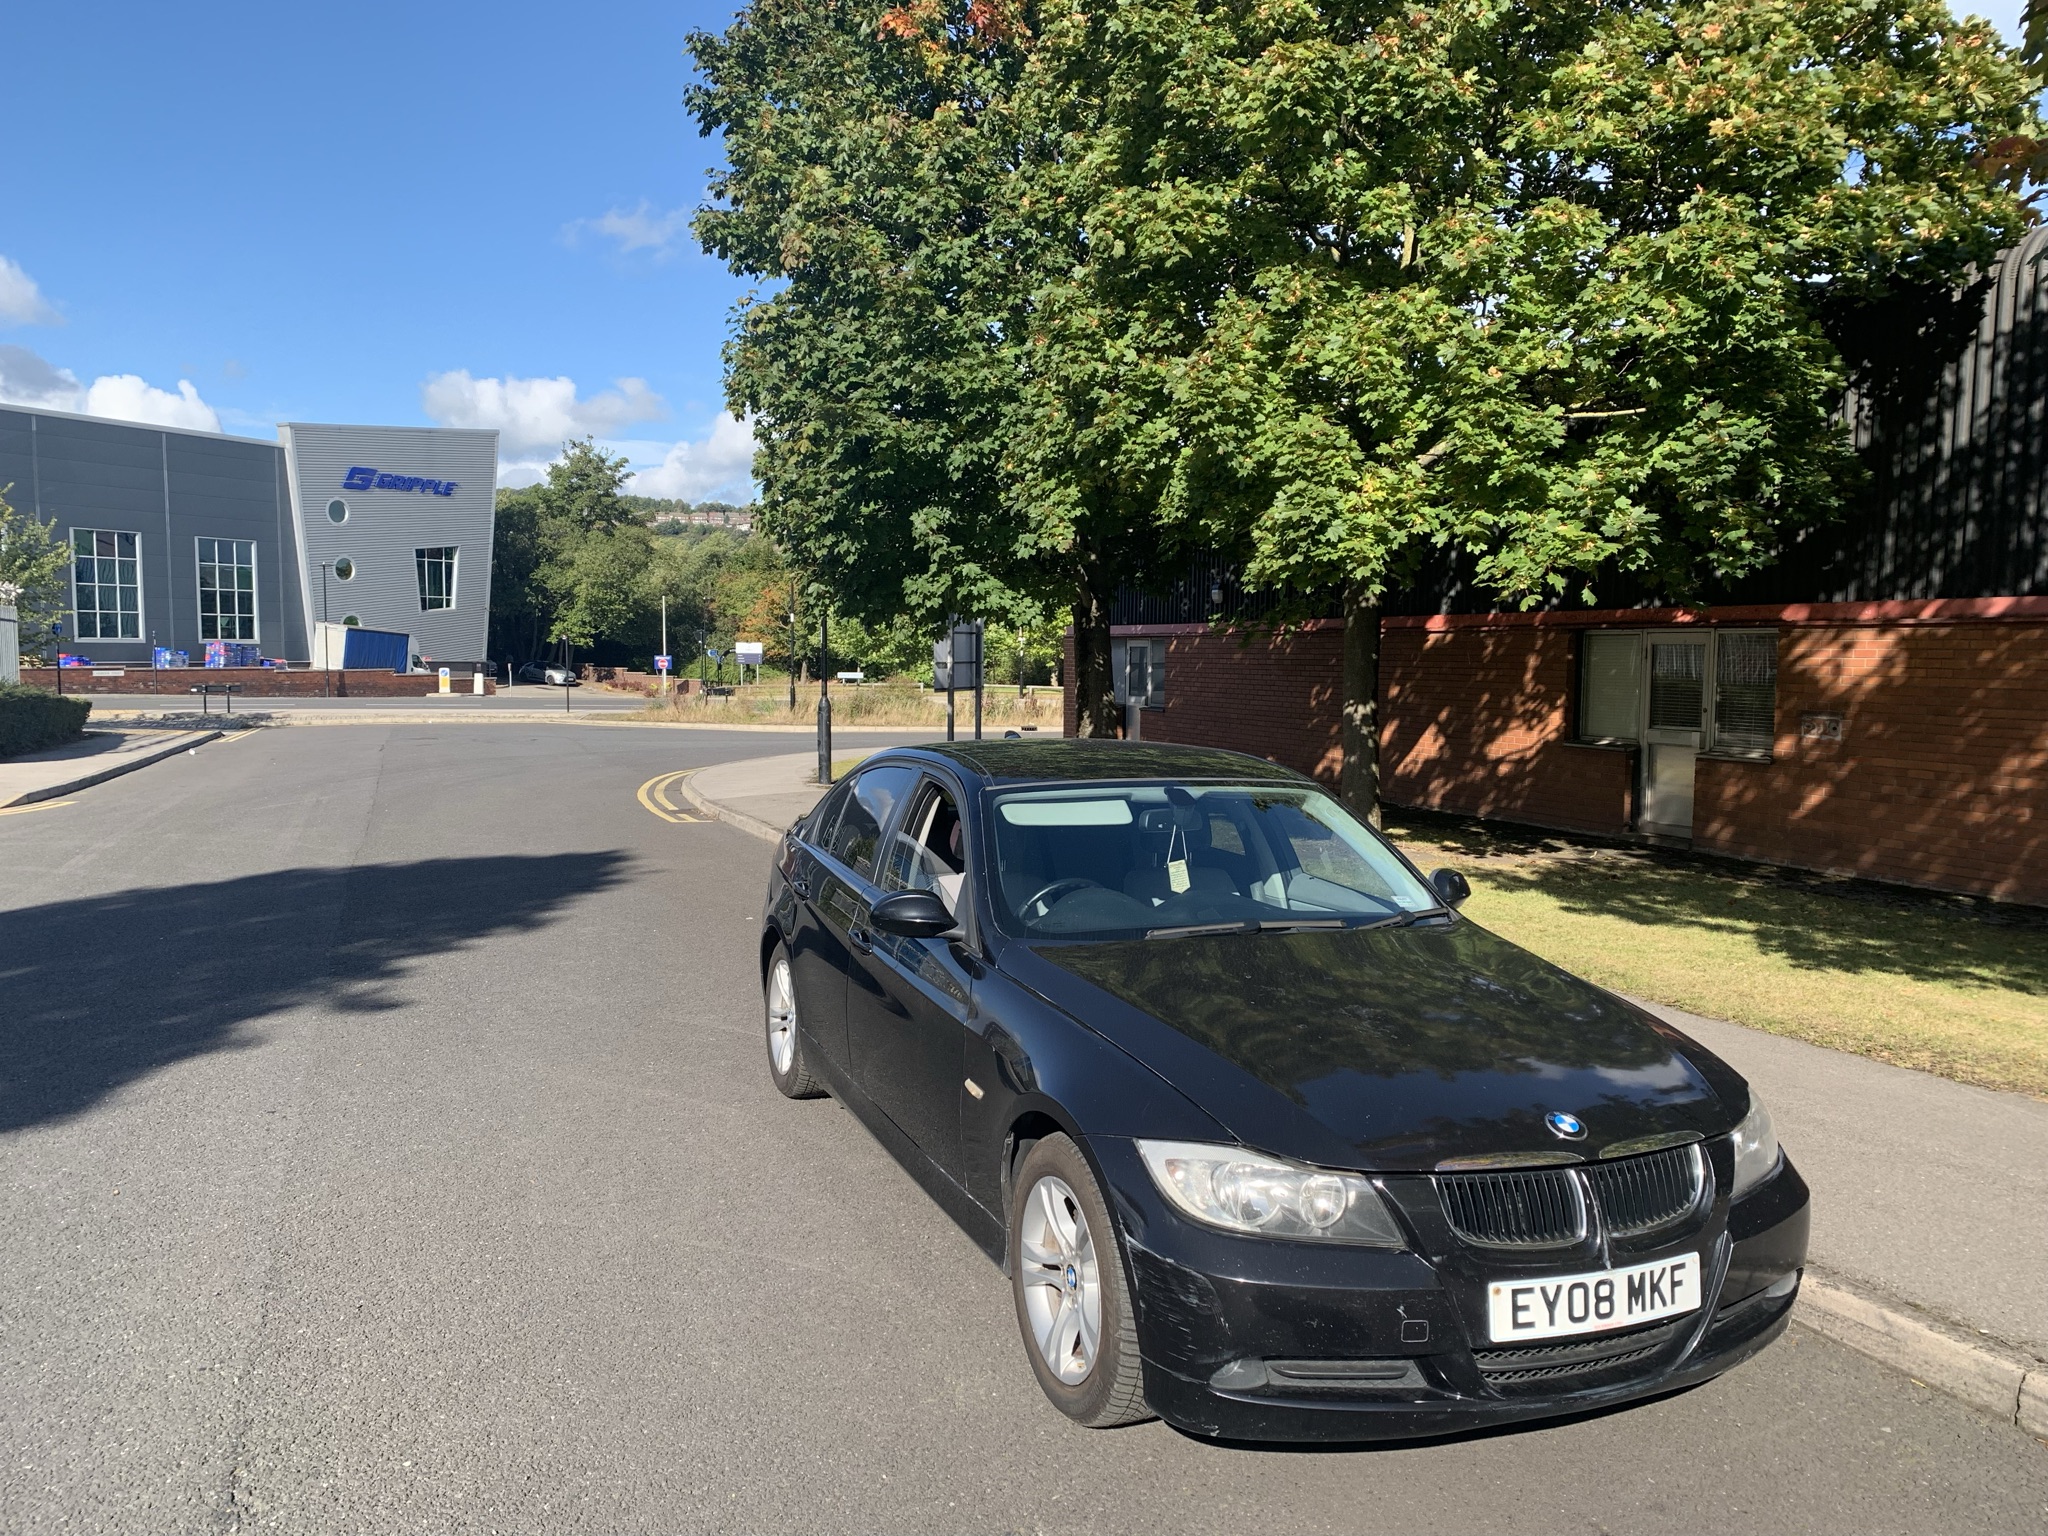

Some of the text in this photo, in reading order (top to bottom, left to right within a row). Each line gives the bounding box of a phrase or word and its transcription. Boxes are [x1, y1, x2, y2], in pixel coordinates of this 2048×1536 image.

[375, 473, 457, 496] GRIPPLE
[1511, 1262, 1687, 1331] EY08 MKF
